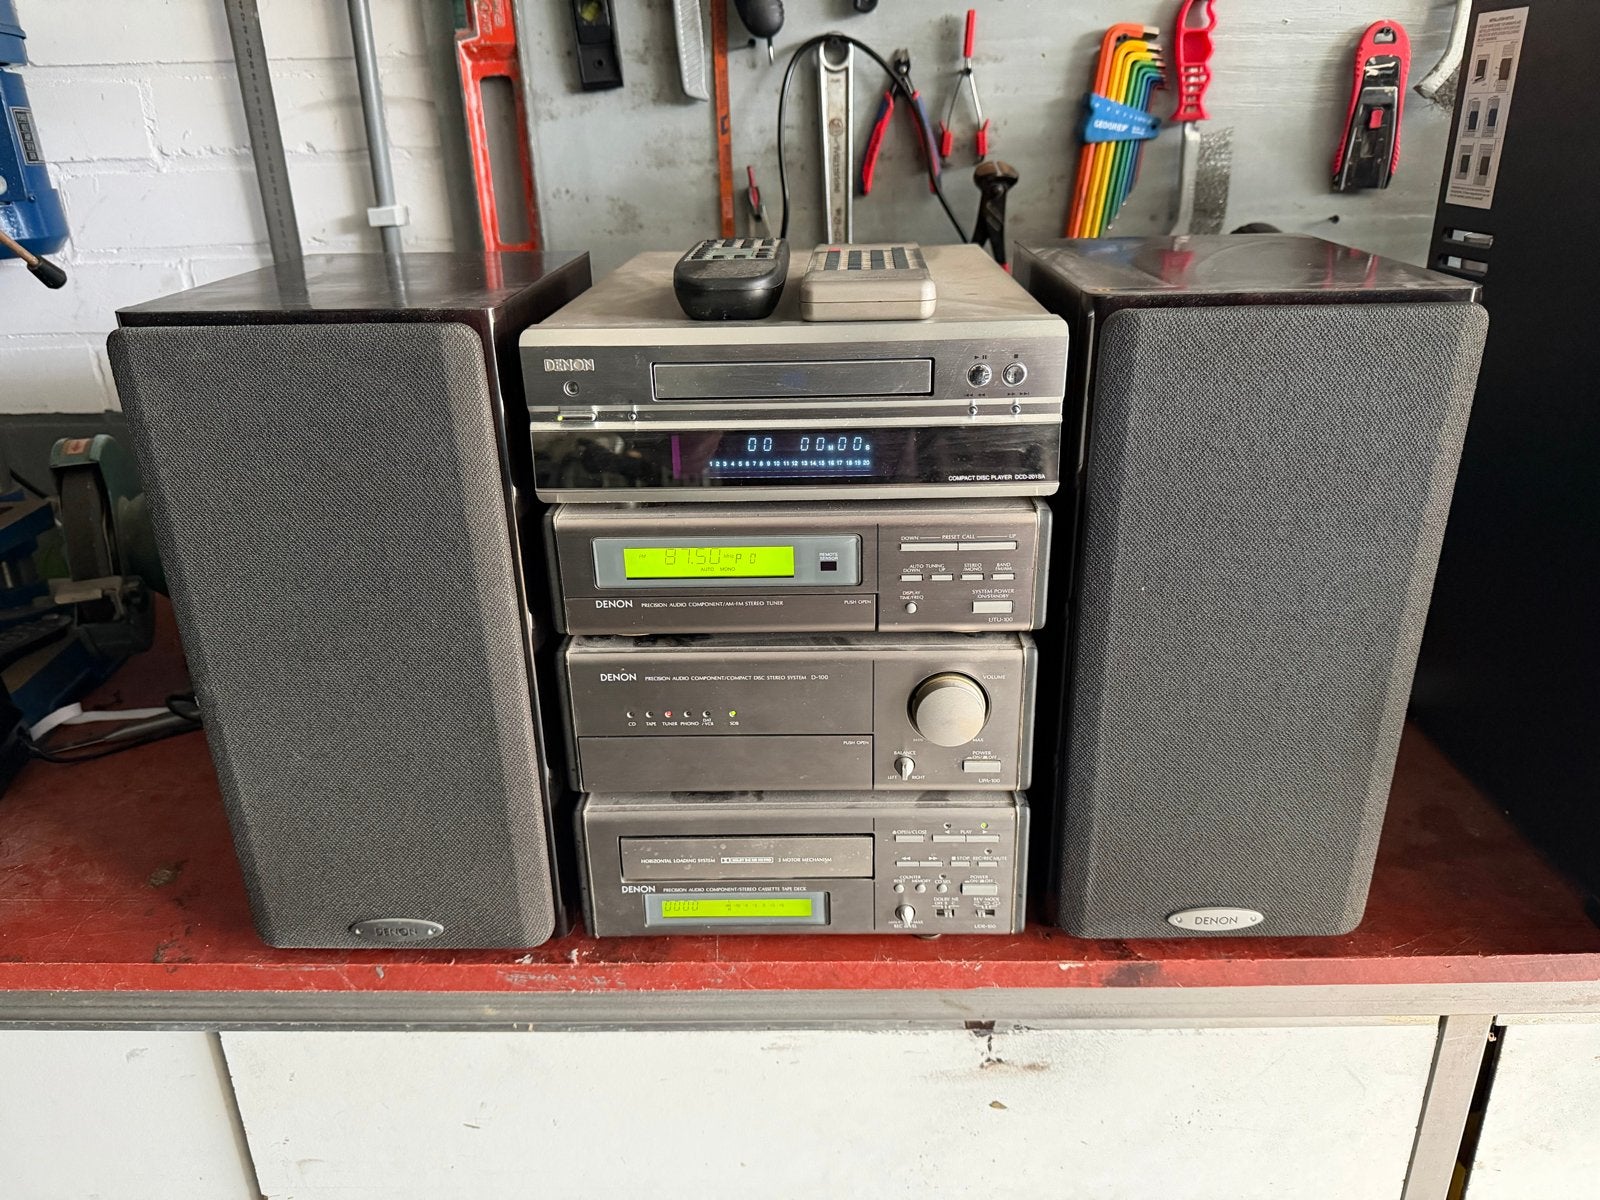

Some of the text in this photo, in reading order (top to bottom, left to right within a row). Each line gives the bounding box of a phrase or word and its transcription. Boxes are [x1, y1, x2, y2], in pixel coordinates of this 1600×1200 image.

[544, 358, 595, 372] DENON
[747, 437, 772, 452] 00
[665, 548, 721, 565] 87.50
[595, 600, 633, 609] DENON
[600, 673, 637, 682] DENON
[1194, 916, 1238, 925] DENON
[375, 928, 417, 936] DENON
